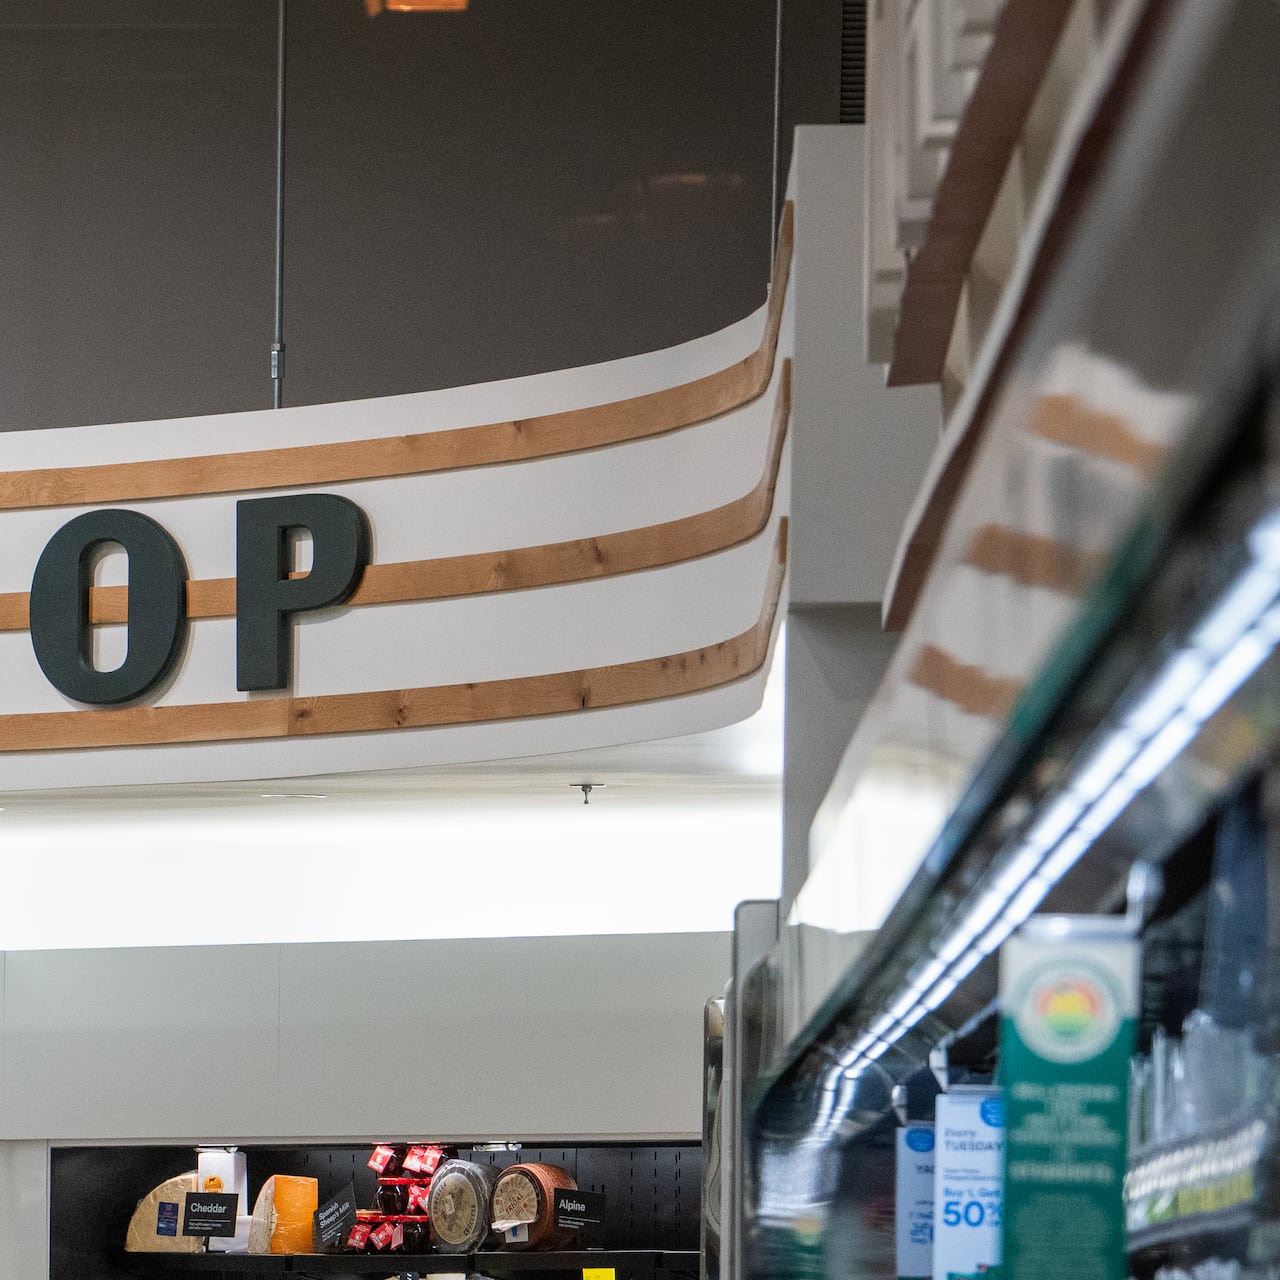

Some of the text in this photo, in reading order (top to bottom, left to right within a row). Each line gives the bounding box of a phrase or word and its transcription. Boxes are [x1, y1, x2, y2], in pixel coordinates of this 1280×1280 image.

[944, 1140, 1005, 1151] TUESDAY
[944, 1187, 966, 1199] Buy
[190, 1203, 227, 1213] Cheddar
[319, 1201, 339, 1220] Spanish
[559, 1199, 586, 1212] Alpine
